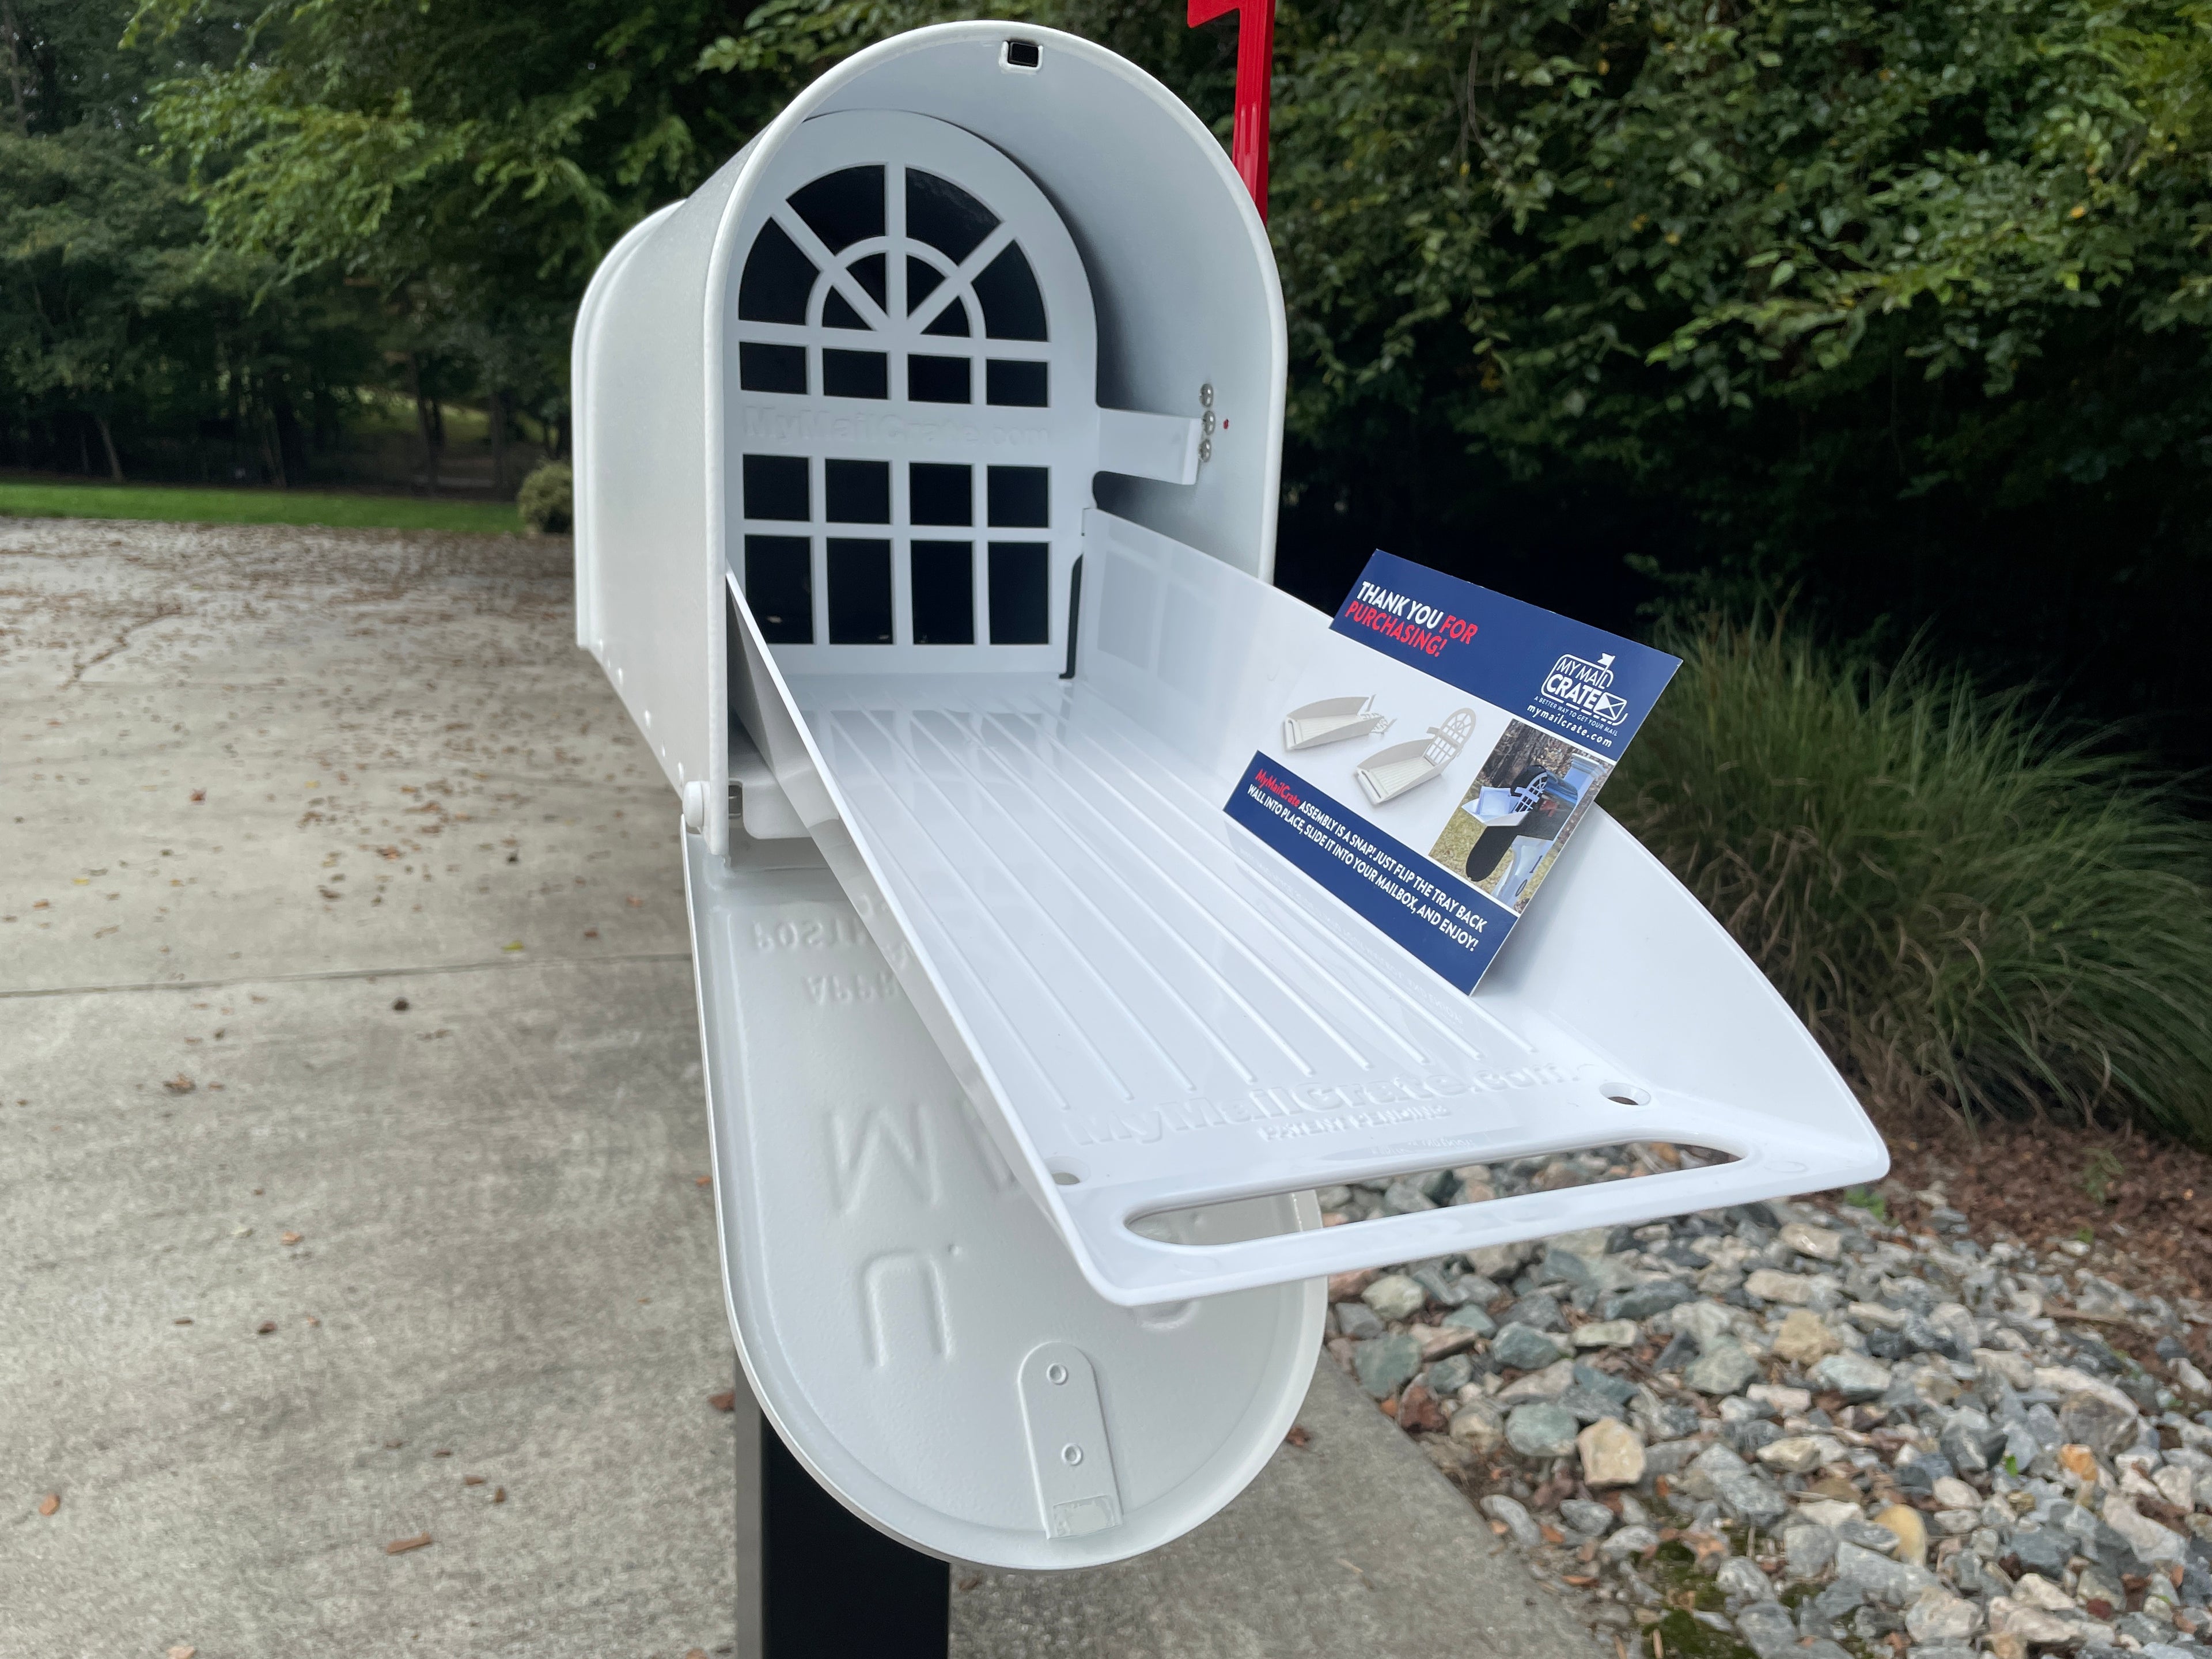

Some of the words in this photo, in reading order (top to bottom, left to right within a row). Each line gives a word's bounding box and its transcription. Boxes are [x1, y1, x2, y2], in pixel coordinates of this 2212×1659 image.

[1345, 600, 1448, 657] PURCHASING!
[1357, 581, 1410, 616] THANK
[1407, 600, 1444, 629] YOU
[1439, 615, 1478, 644] FOR
[1547, 674, 1603, 709] CRATE
[1556, 658, 1581, 676] MY
[1575, 665, 1608, 689] MAIL
[1527, 704, 1612, 748] mymailcrate.com
[1539, 697, 1557, 709] BETTER
[1558, 706, 1569, 714] WAY
[1577, 714, 1589, 722] GET
[1589, 719, 1604, 730] YOUR
[1604, 726, 1618, 737] MAIL
[1248, 784, 1266, 804] WALL
[1264, 796, 1283, 815] INTO
[1281, 808, 1305, 834] PLACE,
[1304, 824, 1327, 846] SLIDE
[1324, 838, 1336, 852] IT
[1332, 844, 1354, 865] INTO
[1353, 857, 1378, 882] YOUR
[1375, 874, 1418, 914] MAILBOX,
[1416, 904, 1441, 925] AND
[1439, 918, 1479, 952] ENJOY!
[1255, 768, 1301, 807] MyMailCrate
[1298, 800, 1338, 831] ASSEMBLY
[1335, 824, 1346, 837] IS
[1342, 831, 1351, 842] A
[1350, 834, 1377, 858] SNAP!
[1373, 850, 1396, 871] JUST
[1393, 863, 1415, 883] FLIP
[1413, 876, 1434, 897] THE
[1431, 888, 1459, 912] TRAY
[1455, 905, 1487, 933] BACK
